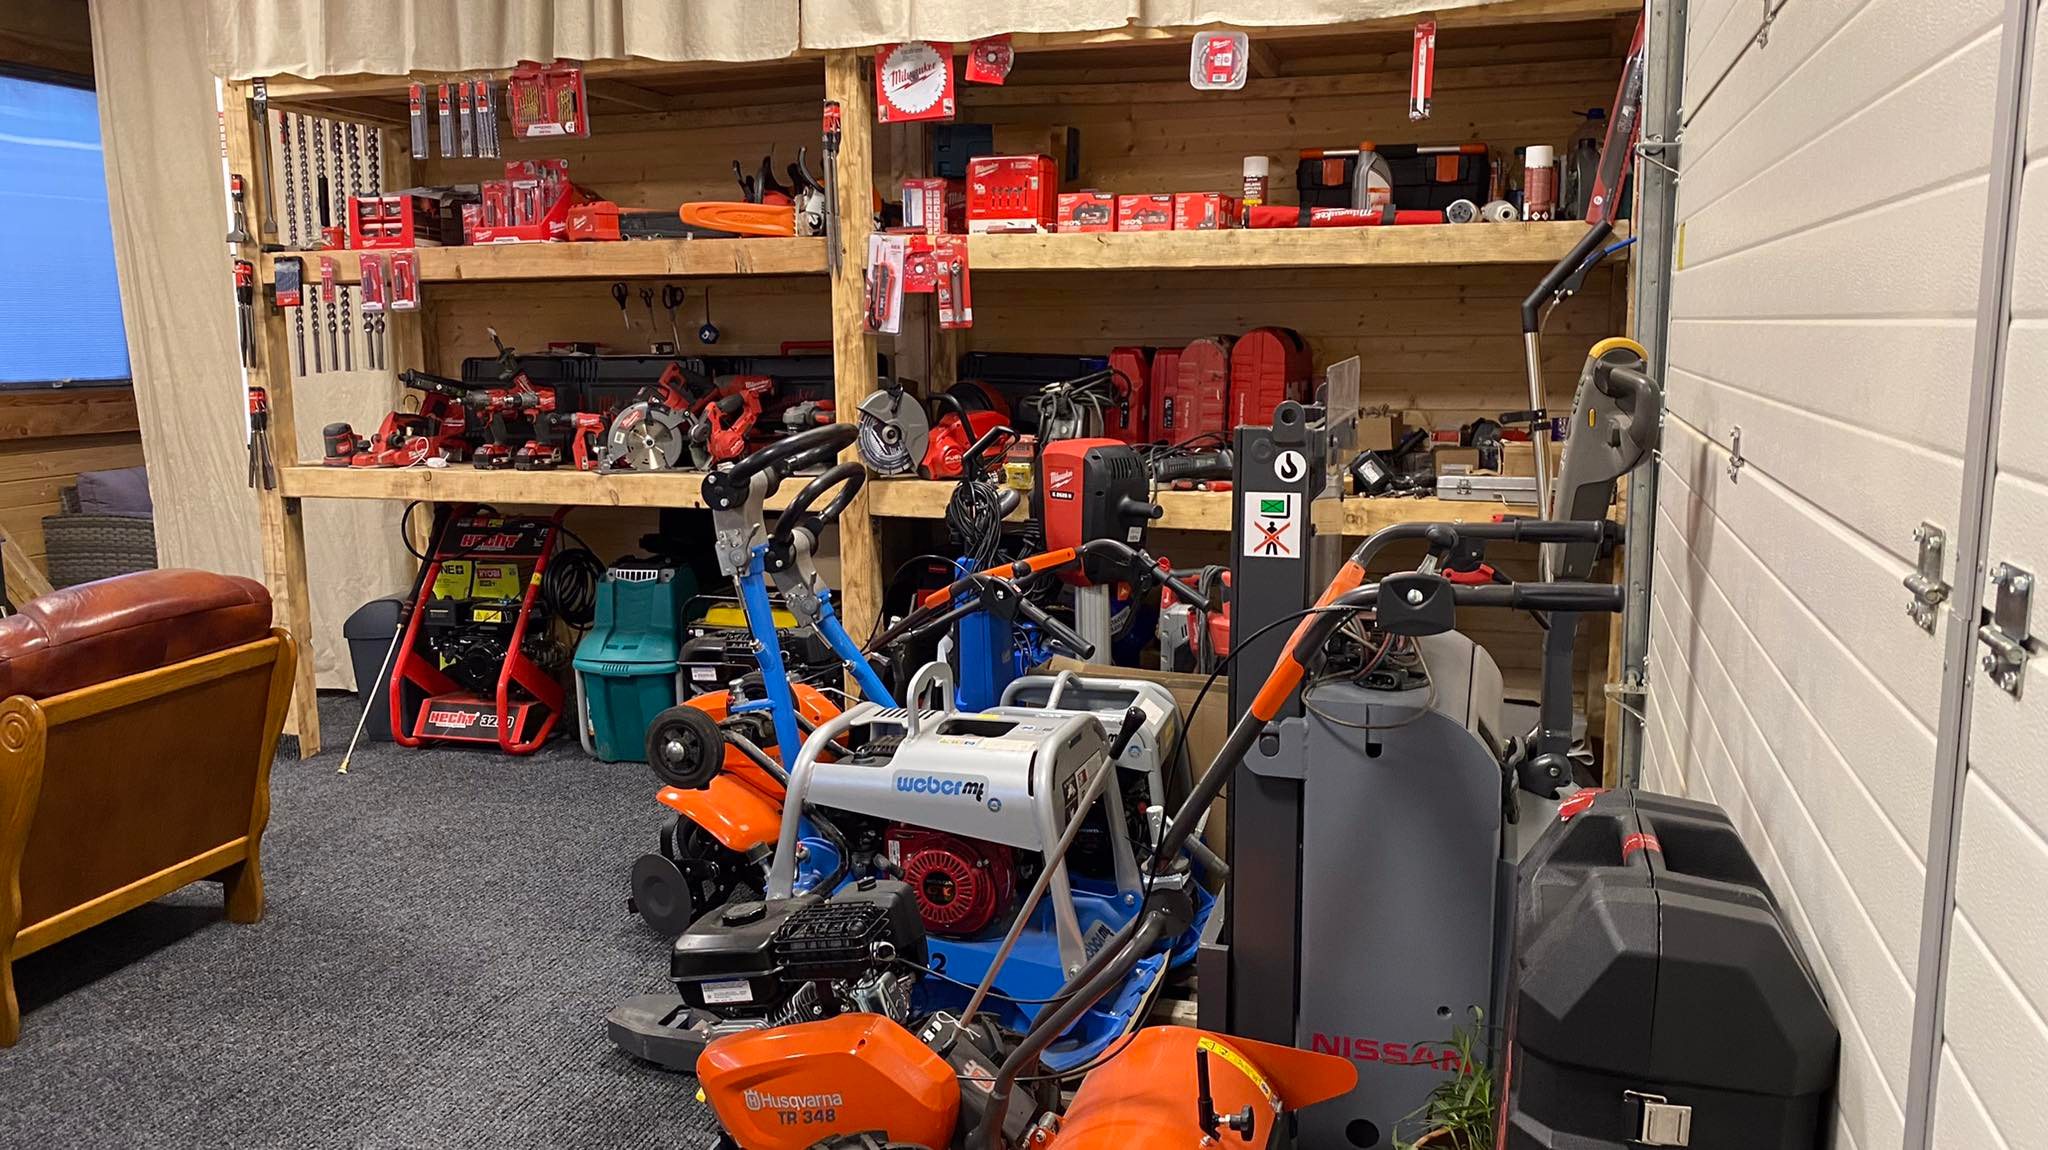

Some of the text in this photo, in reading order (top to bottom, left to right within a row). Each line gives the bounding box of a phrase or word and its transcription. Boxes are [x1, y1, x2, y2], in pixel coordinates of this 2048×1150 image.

[890, 61, 937, 87] Milwaukee
[1312, 207, 1375, 222] Milwaukee
[896, 775, 963, 796] weber
[1311, 1032, 1473, 1077] NISSAN
[760, 1091, 843, 1112] Husqvarna
[777, 1109, 837, 1125] TR 348
